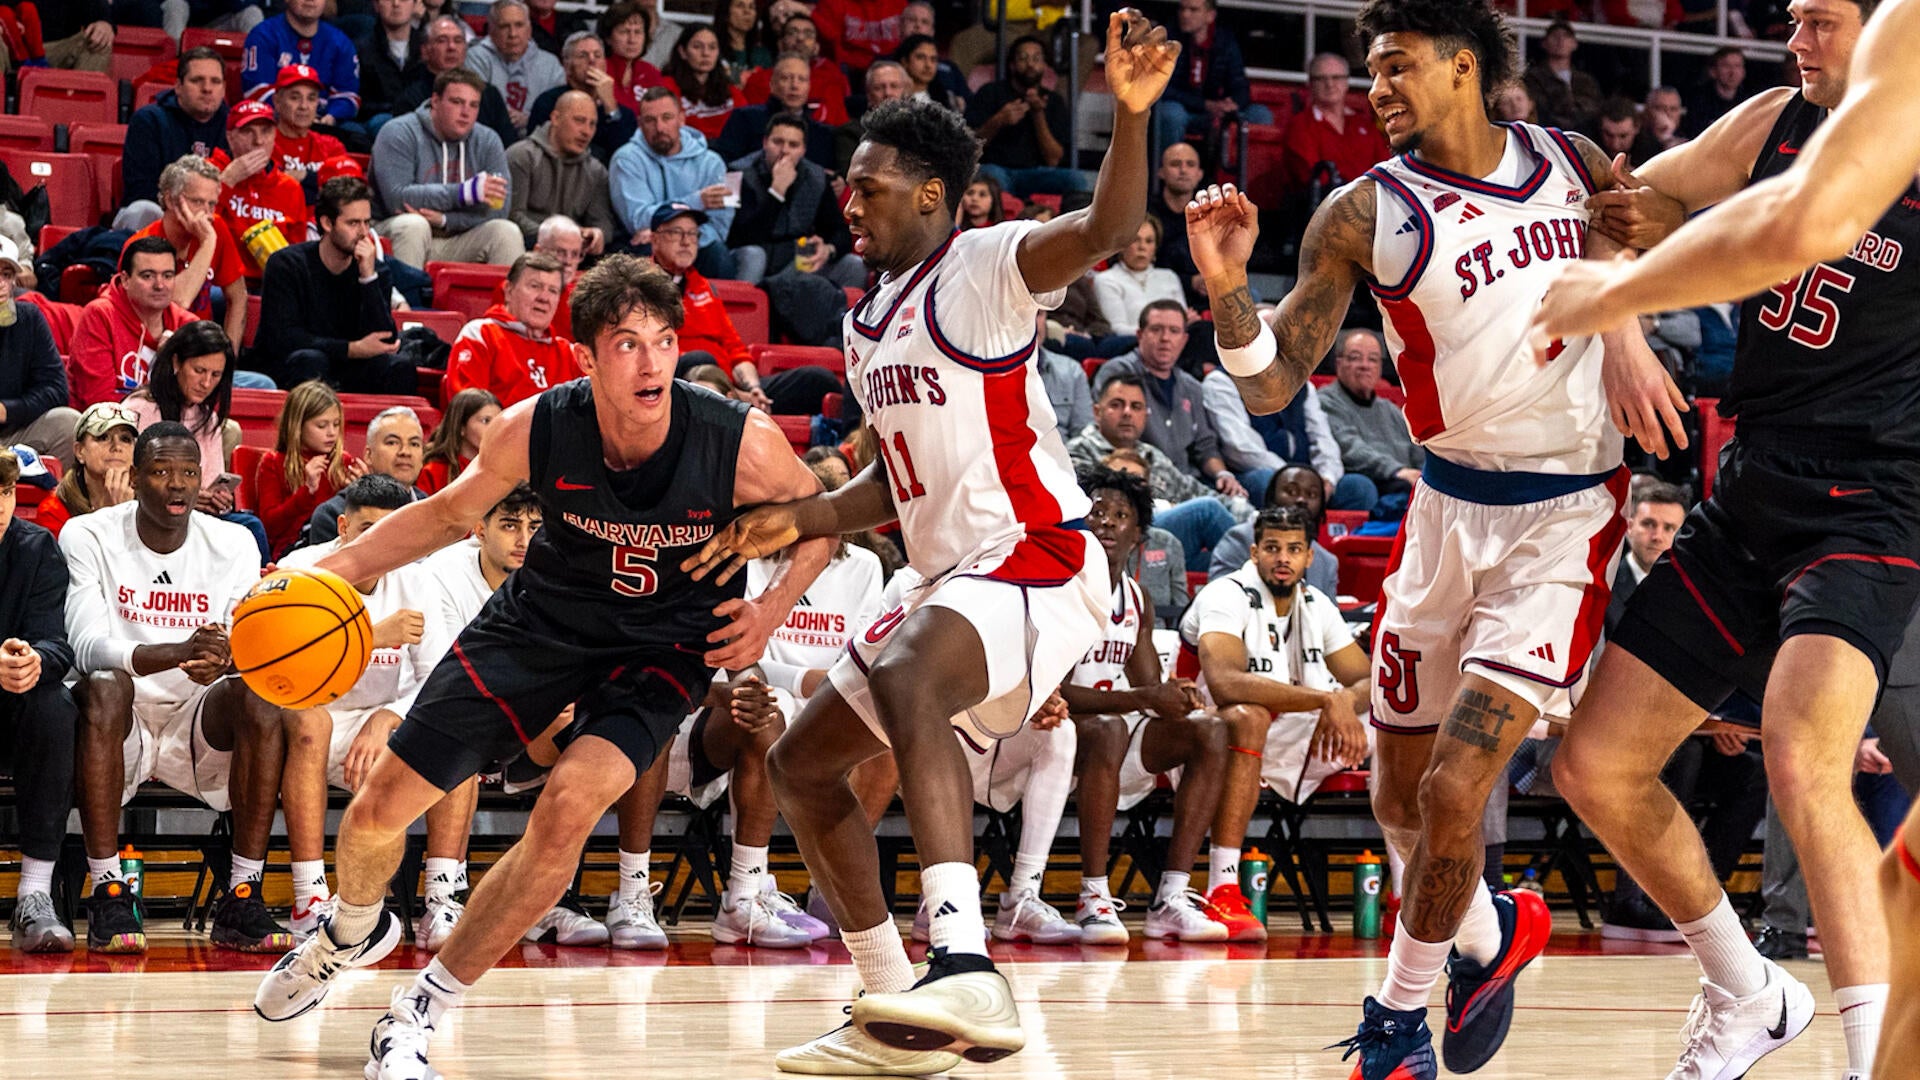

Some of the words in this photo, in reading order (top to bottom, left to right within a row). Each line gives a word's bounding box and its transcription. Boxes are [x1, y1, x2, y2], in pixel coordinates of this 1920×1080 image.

[1455, 240, 1505, 303] ST.
[1758, 262, 1856, 350] 35
[866, 364, 947, 411] JOHN'S
[880, 430, 927, 503] 11
[610, 545, 659, 598] 5
[118, 585, 139, 608] ST.
[142, 590, 209, 613] JOHN'S
[123, 610, 201, 628] BASKETBALL
[785, 611, 845, 633] JOHN'S
